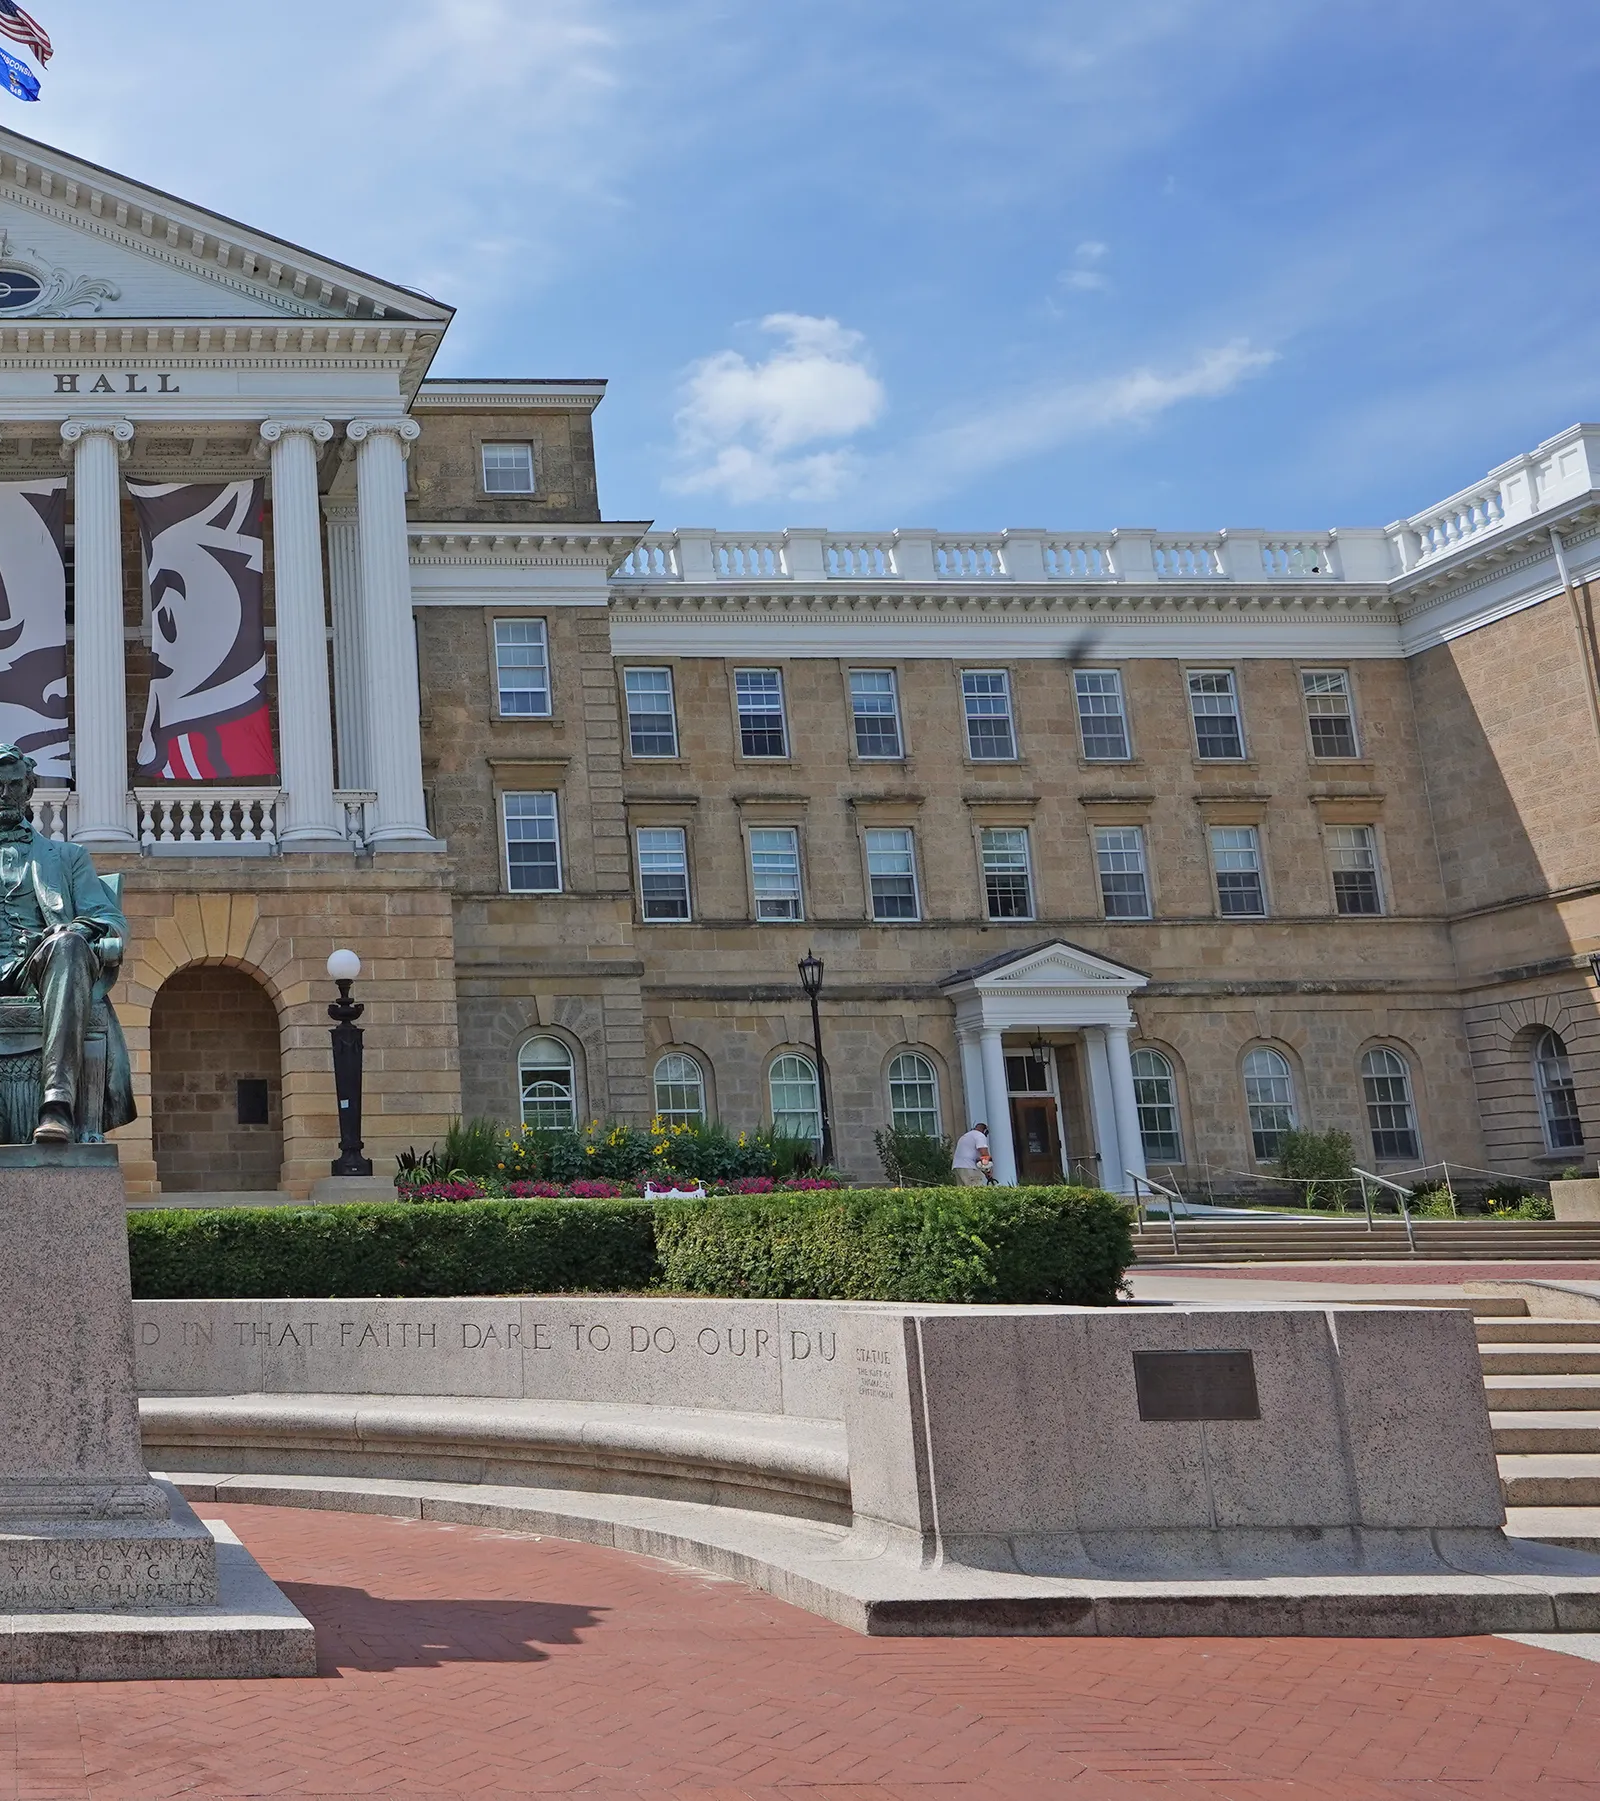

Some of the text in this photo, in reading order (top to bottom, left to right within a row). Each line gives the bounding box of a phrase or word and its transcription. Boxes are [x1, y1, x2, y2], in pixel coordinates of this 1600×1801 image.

[53, 373, 180, 393] HALL
[182, 1322, 214, 1346] IN
[234, 1322, 319, 1347] THAT
[340, 1322, 438, 1348] FAITH
[461, 1323, 552, 1350] DARE
[569, 1324, 611, 1352] TO
[630, 1325, 676, 1354] DO
[698, 1327, 777, 1359] OUR
[790, 1330, 837, 1362] DU
[856, 1348, 891, 1365] STATUE
[50, 1564, 206, 1581] GEORGIA
[9, 1582, 208, 1601] MASSACHUSETTS
